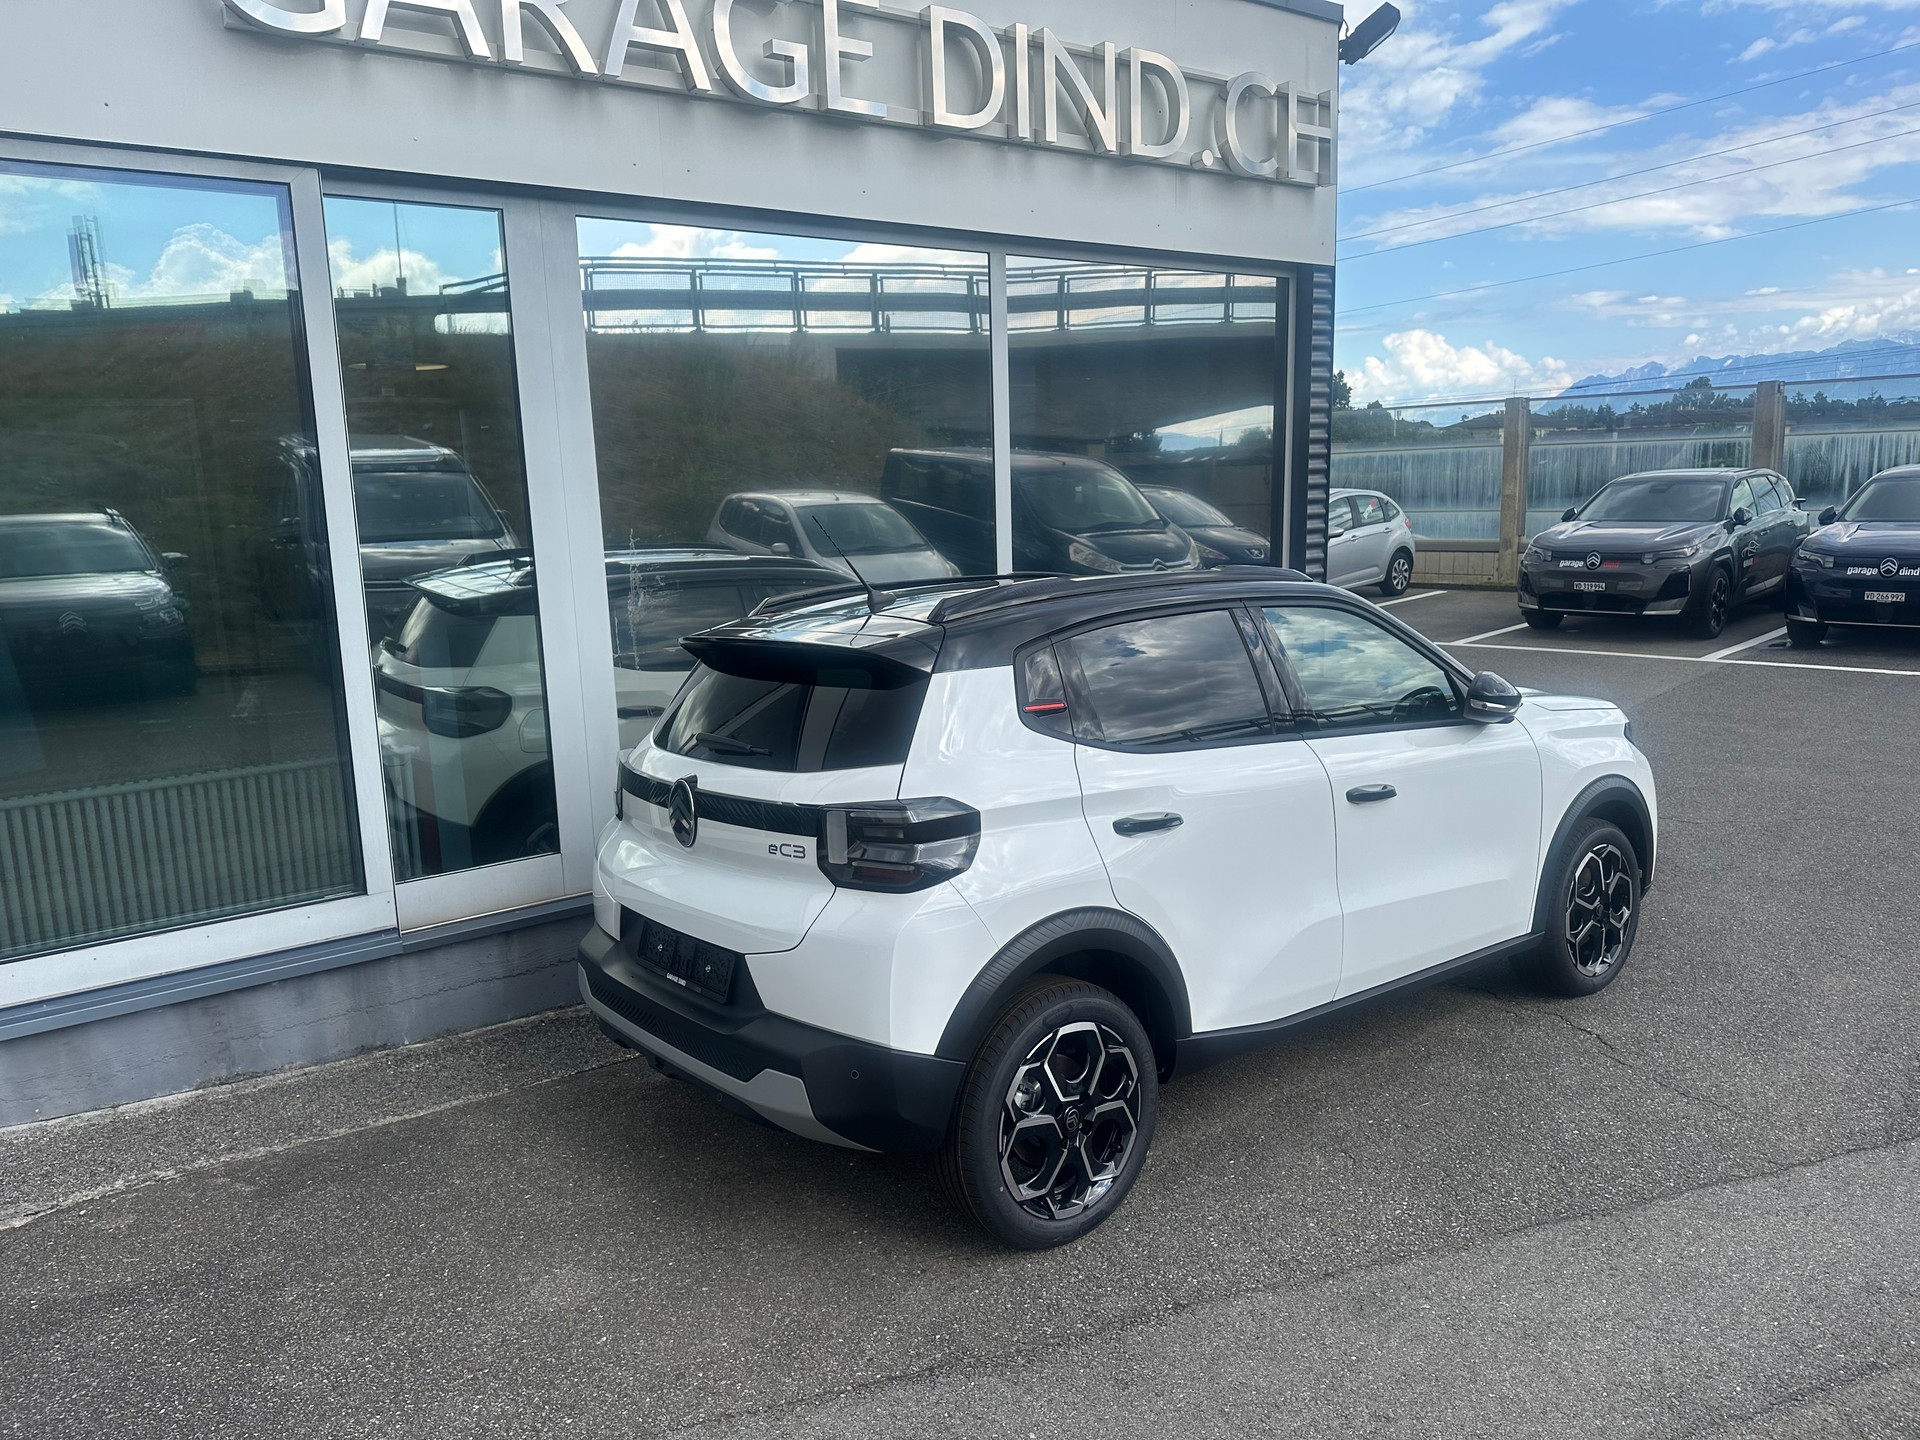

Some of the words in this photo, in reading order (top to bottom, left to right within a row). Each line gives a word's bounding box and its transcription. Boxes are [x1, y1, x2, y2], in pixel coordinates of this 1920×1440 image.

[223, 0, 887, 118] AGE
[921, 4, 1338, 187] DIND.CH
[1846, 566, 1879, 576] garage
[1898, 566, 1920, 576] dind
